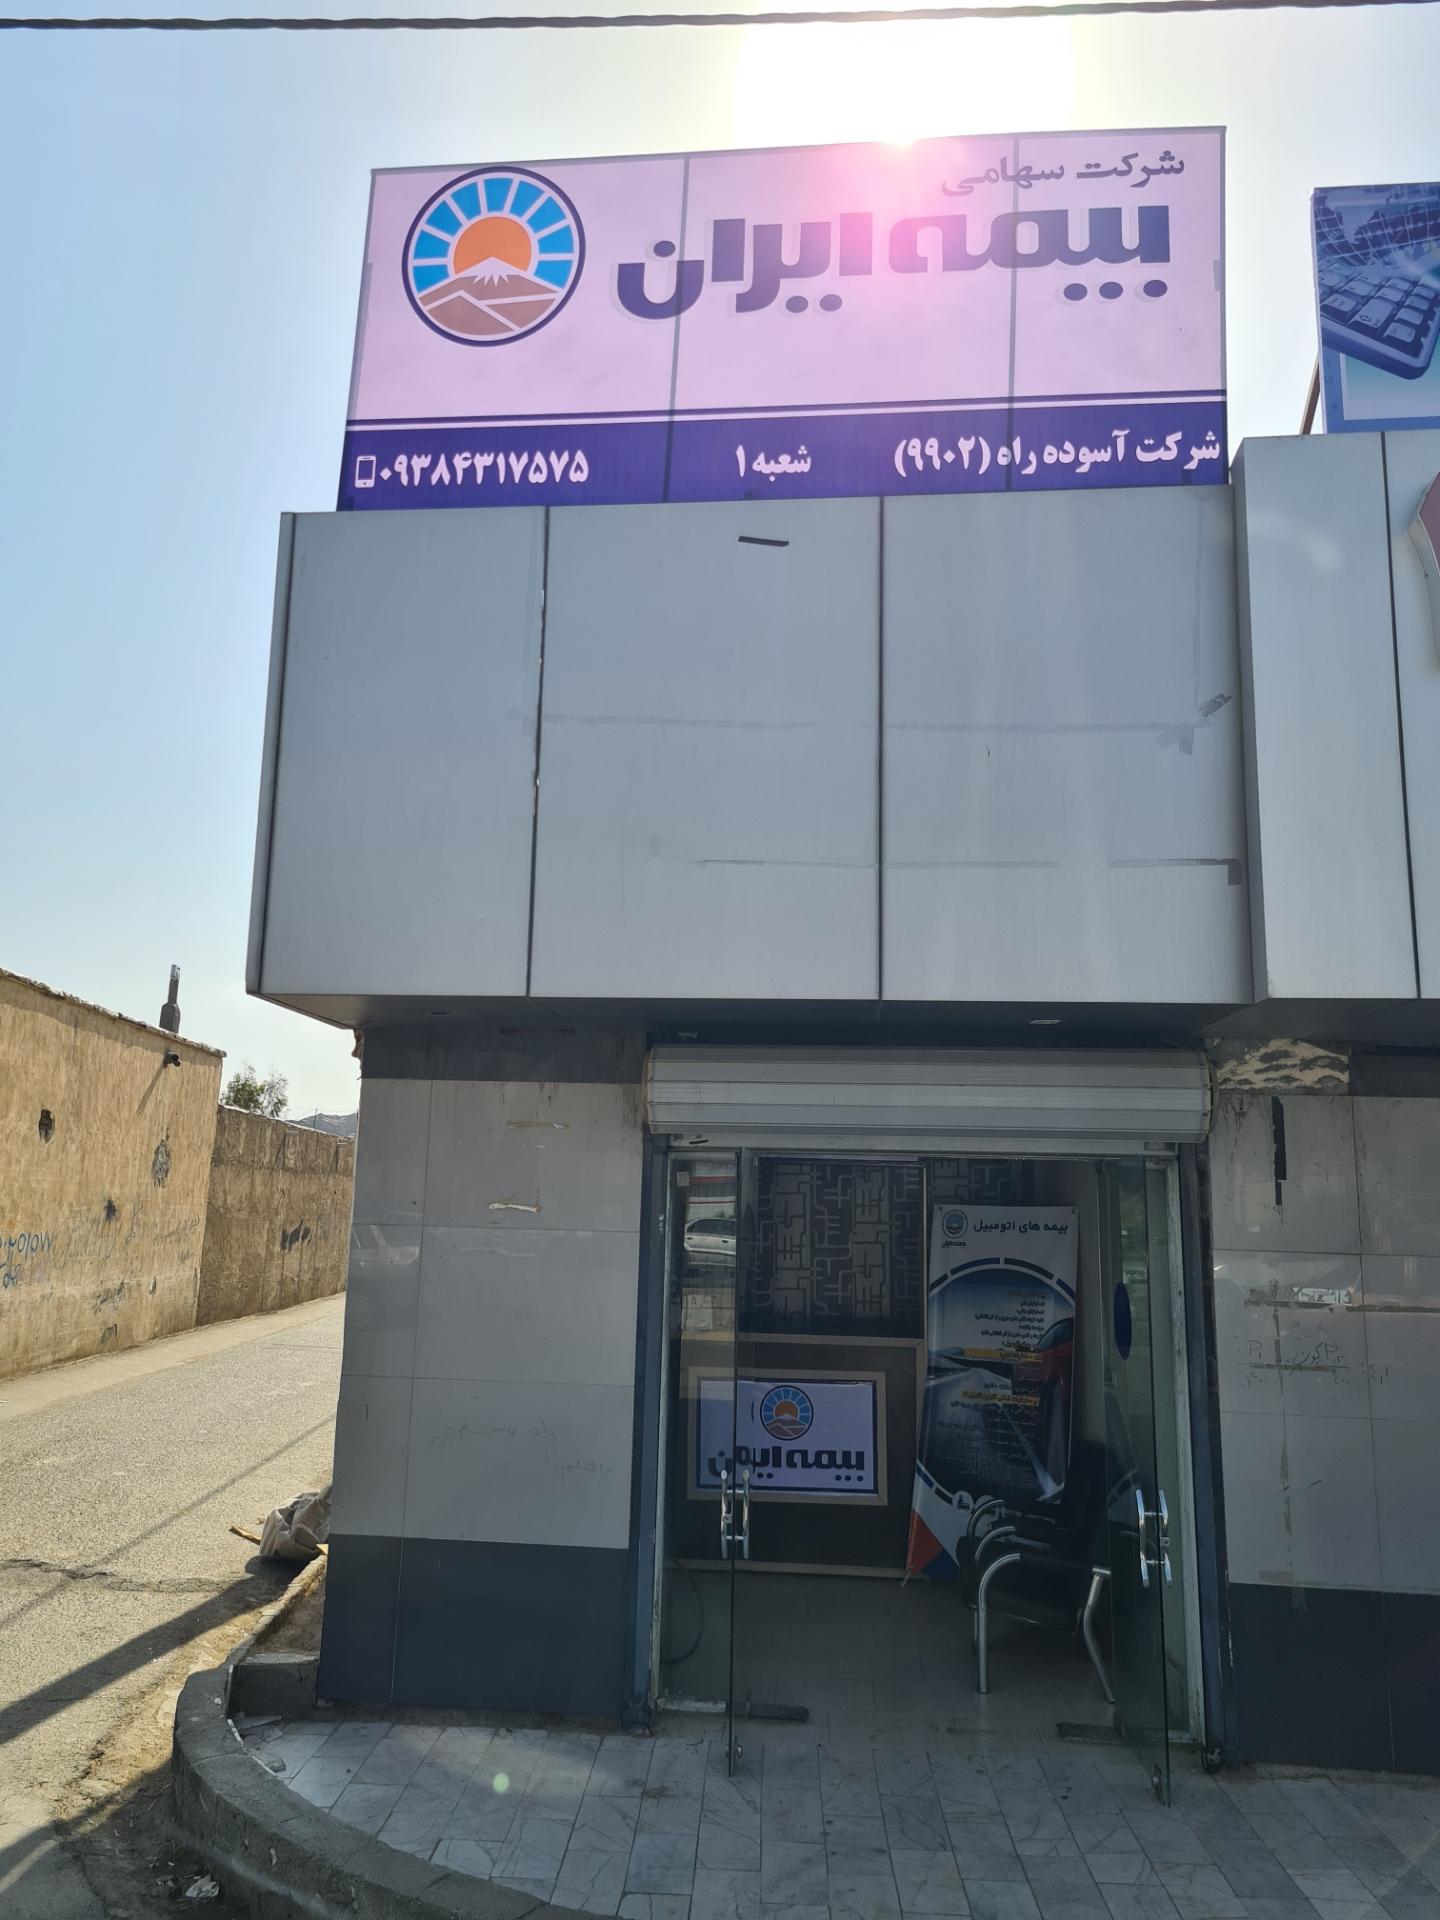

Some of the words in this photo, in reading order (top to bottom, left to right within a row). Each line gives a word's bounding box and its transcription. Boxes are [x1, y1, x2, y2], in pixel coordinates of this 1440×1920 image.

[941, 157, 1065, 196] سهامی
[1076, 150, 1185, 188] شرکت
[616, 211, 873, 321] ایران
[888, 205, 1171, 301] بیمه
[380, 449, 590, 487] ۰۹۳۸۴۳۱۷۵۷۵
[751, 444, 812, 483] شعبه
[1043, 430, 1130, 473] آسوده
[1135, 430, 1221, 472] شرکت
[972, 1219, 1016, 1233] اتومبیل
[1018, 1220, 1040, 1234] های
[1043, 1221, 1069, 1235] بیمه
[786, 1449, 864, 1482] بیمه
